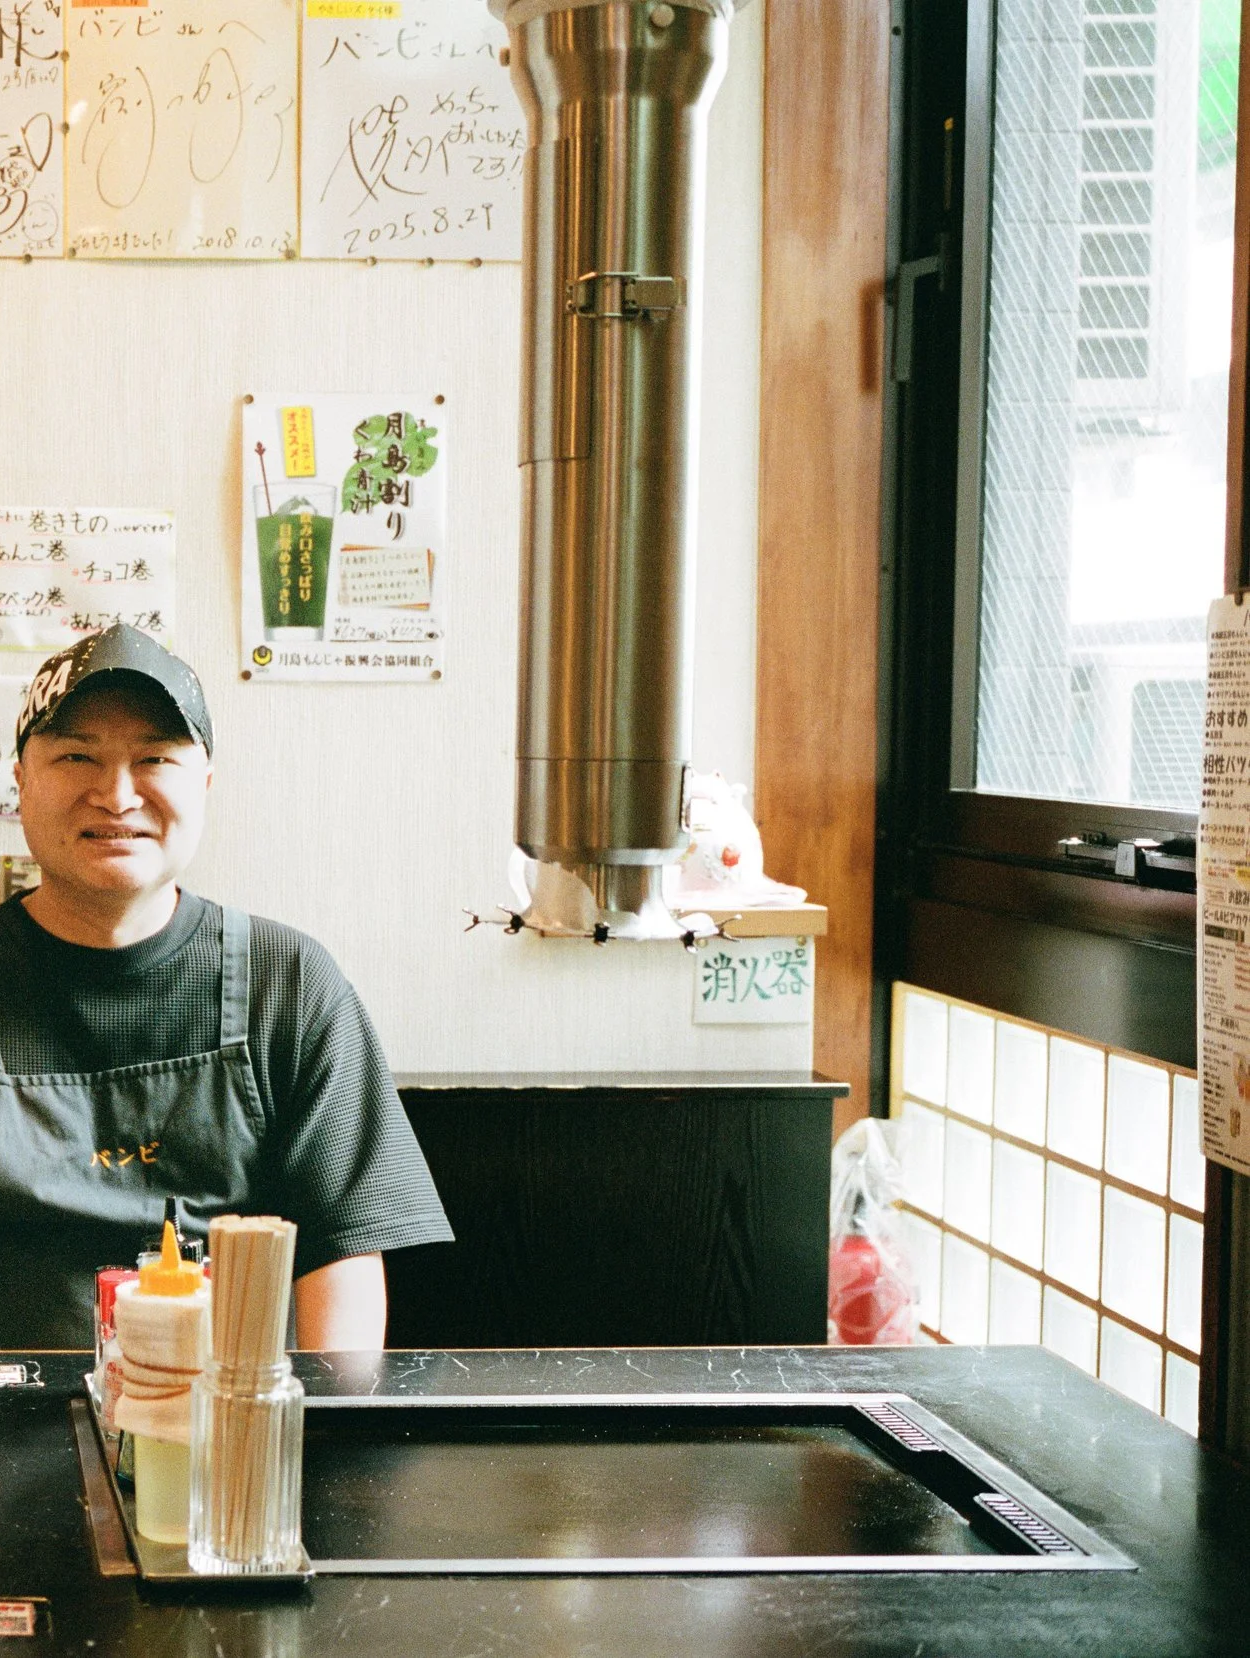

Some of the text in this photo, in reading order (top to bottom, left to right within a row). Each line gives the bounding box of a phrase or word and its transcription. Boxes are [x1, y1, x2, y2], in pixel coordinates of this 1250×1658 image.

[351, 419, 376, 514] くわ青汁
[381, 412, 410, 541] 月島割り
[28, 509, 109, 535] 巻きもの
[82, 557, 155, 582] チョコ巻
[278, 653, 434, 667] 月島もんじゃ振興会協同組合
[1205, 709, 1248, 728] おすすめ
[702, 948, 810, 1003] 消火器
[90, 1140, 161, 1169] バンビ
